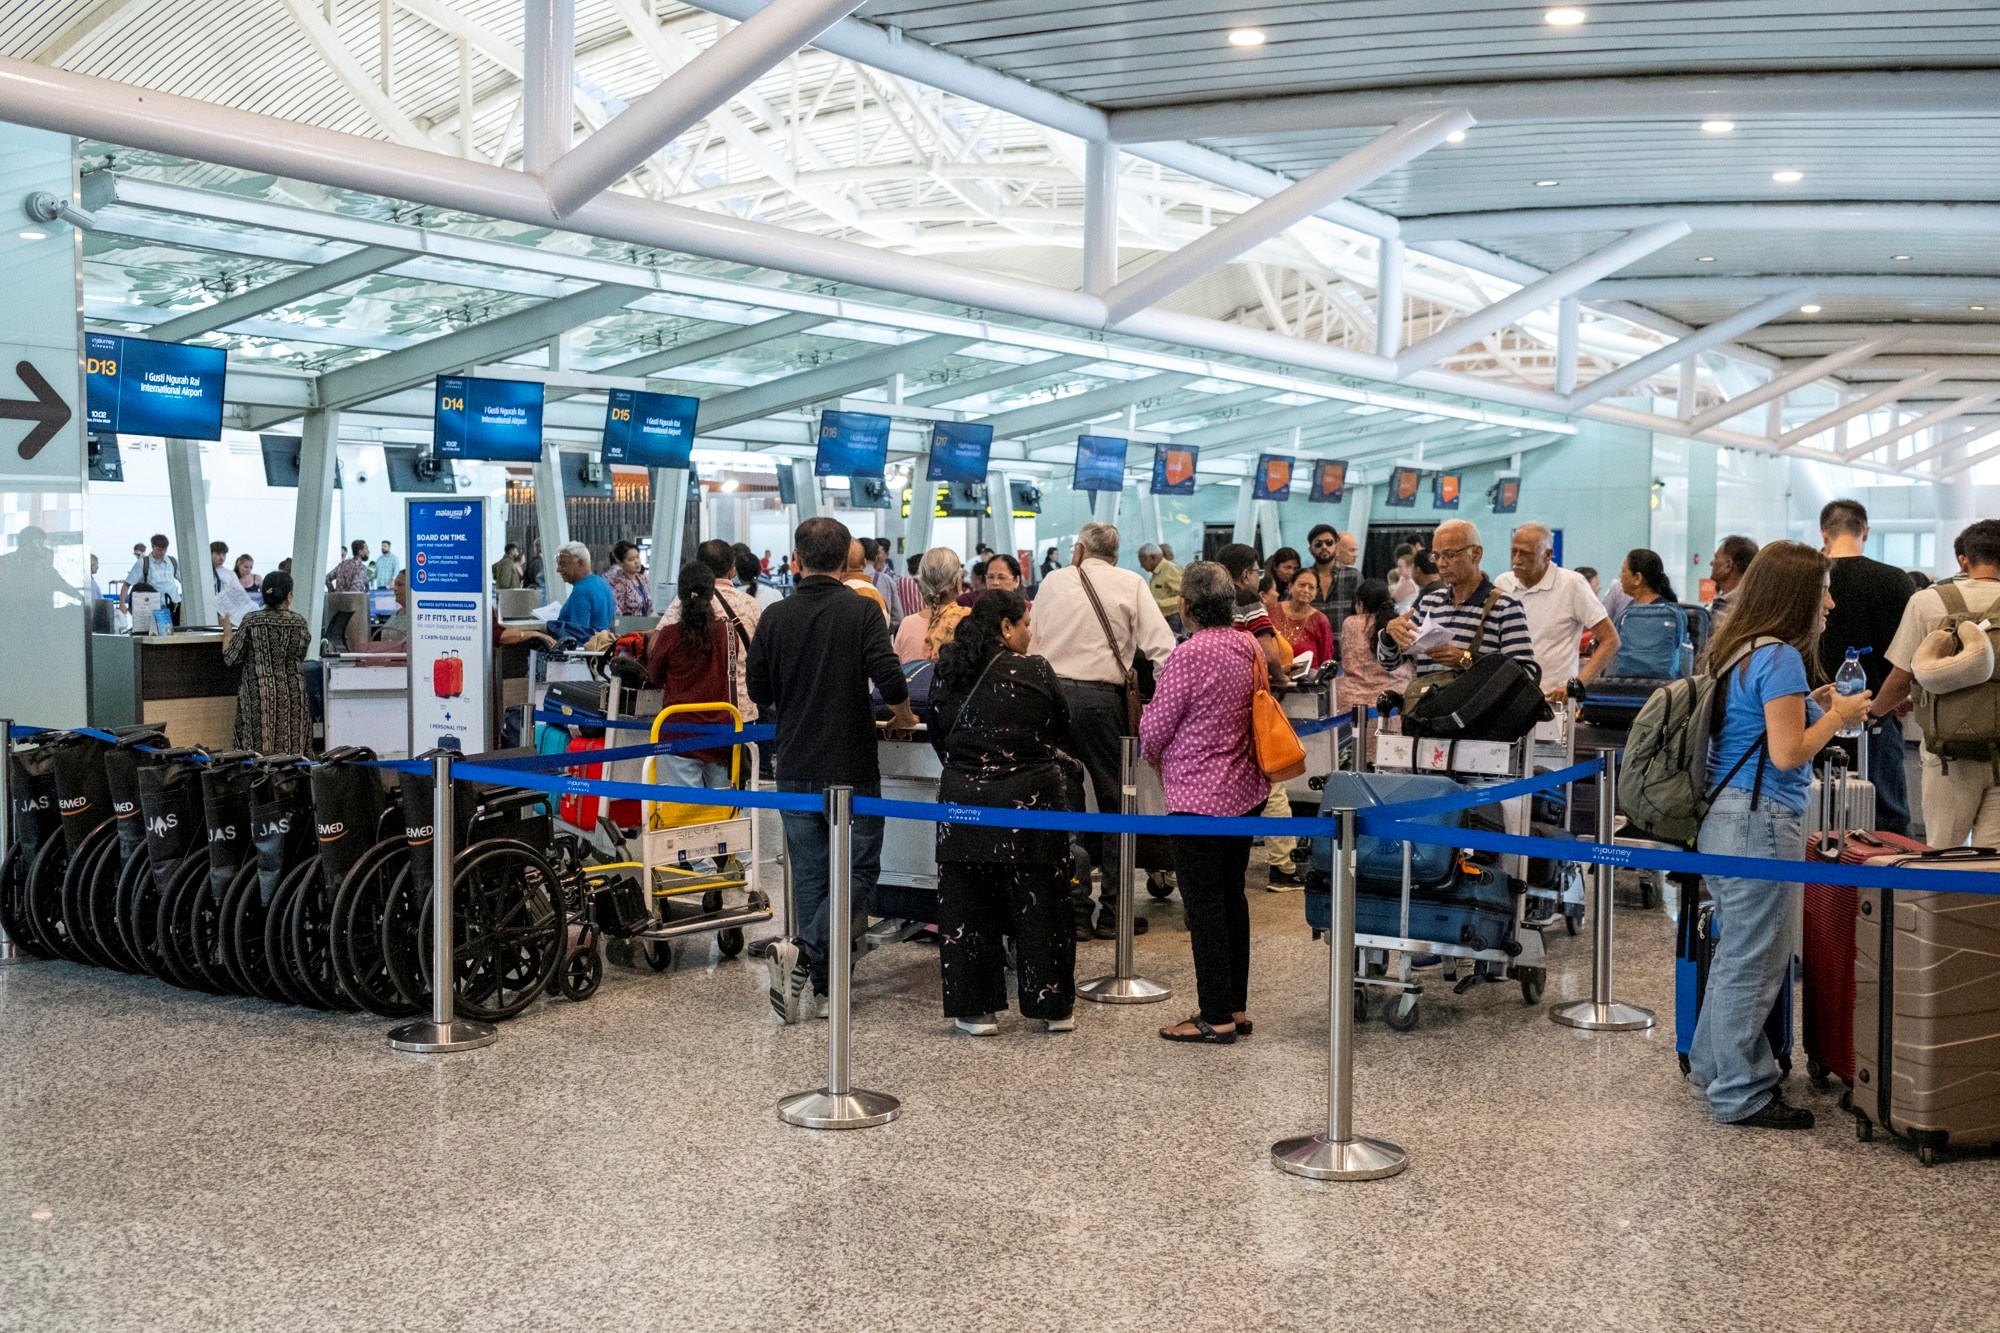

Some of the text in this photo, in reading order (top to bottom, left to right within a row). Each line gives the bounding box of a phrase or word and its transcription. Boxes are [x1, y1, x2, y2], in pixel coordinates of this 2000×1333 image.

[87, 358, 117, 376] D13
[149, 372, 165, 382] Gusti
[166, 374, 189, 386] Ngurah
[190, 377, 200, 386] Rai
[141, 383, 180, 394] International
[181, 387, 203, 398] Airport
[442, 397, 464, 411] D14
[611, 408, 630, 421] D15
[822, 426, 838, 439] D16
[935, 436, 948, 447] D17
[435, 509, 463, 518] malaysia
[432, 614, 449, 623] FITS,
[948, 808, 982, 816] injourney
[207, 825, 237, 842] JAS
[1592, 847, 1632, 858] injourney
